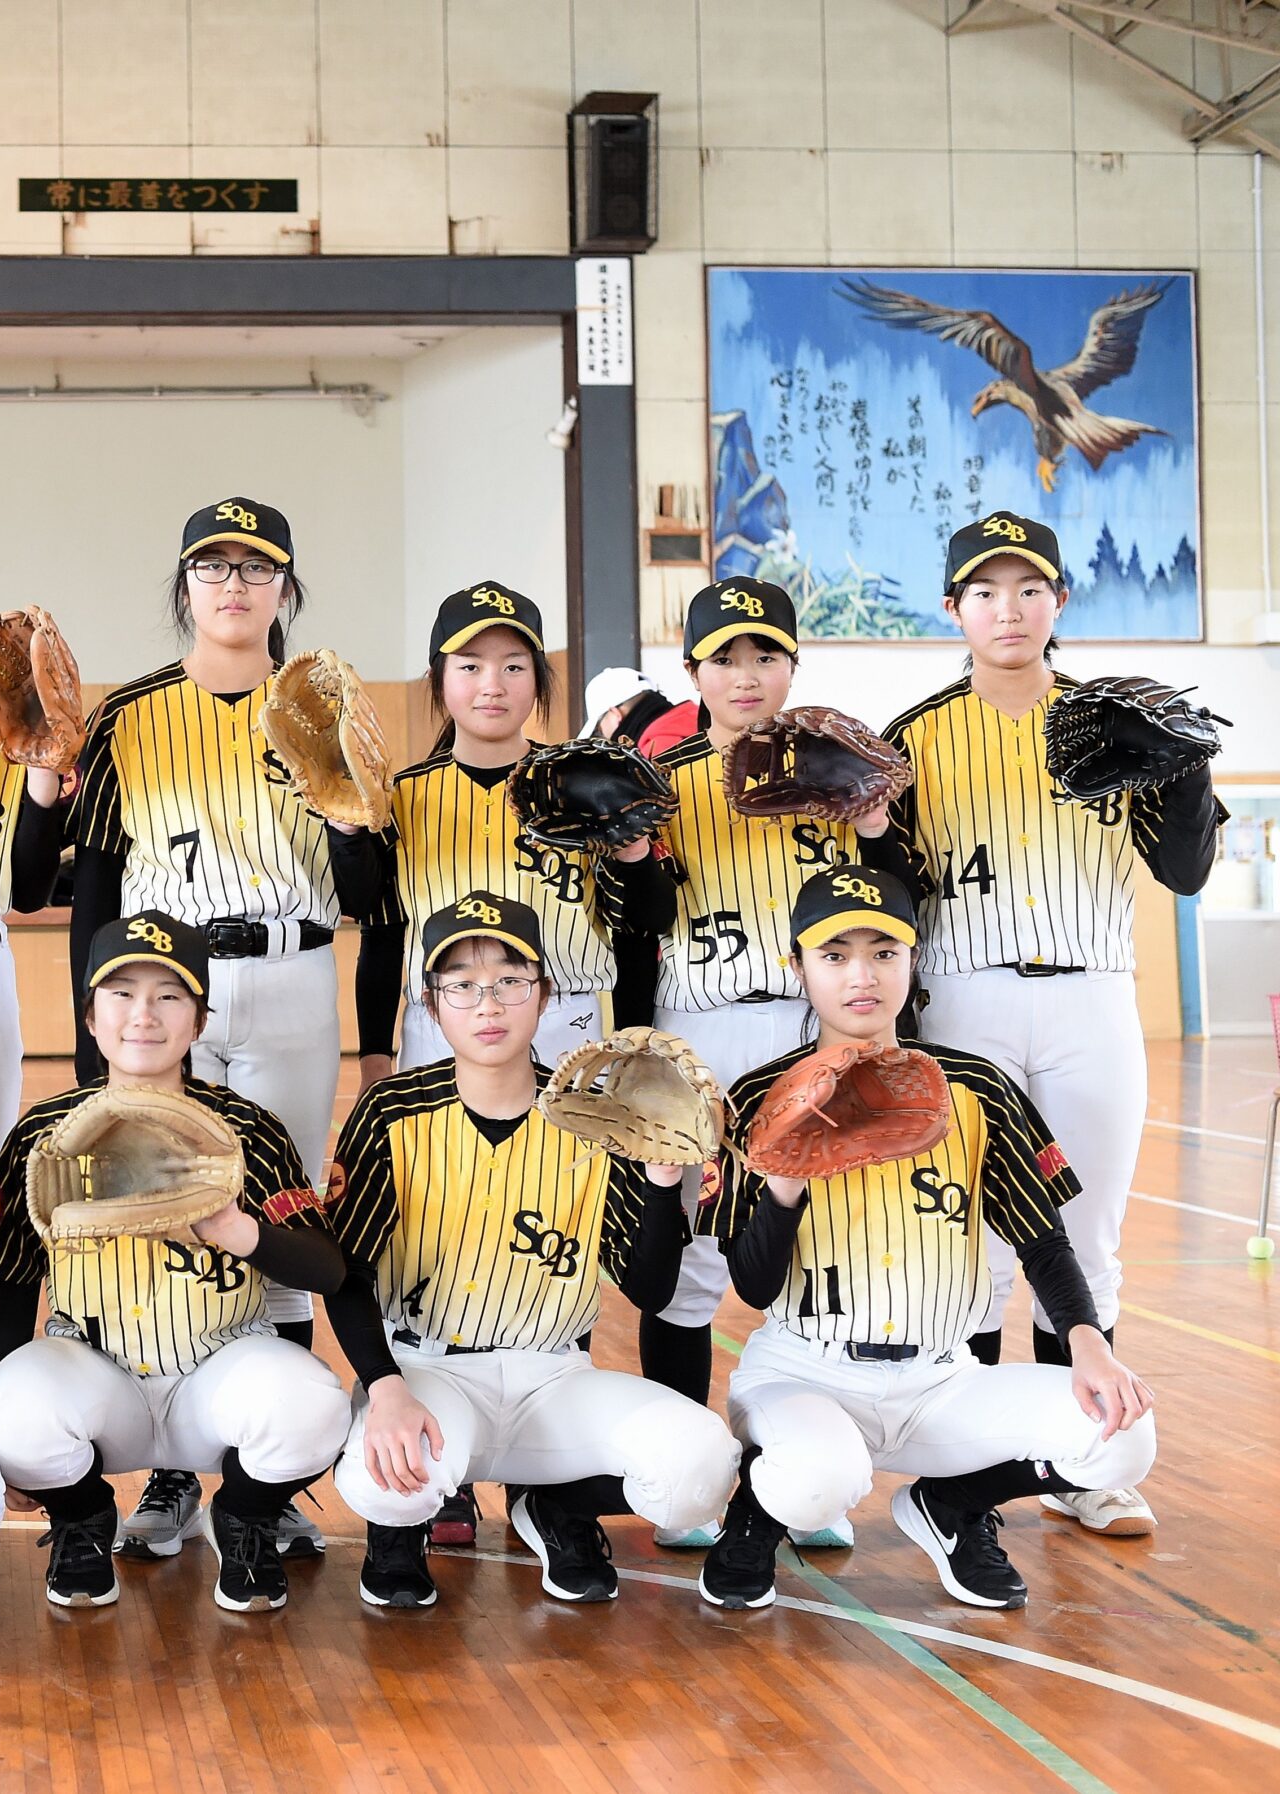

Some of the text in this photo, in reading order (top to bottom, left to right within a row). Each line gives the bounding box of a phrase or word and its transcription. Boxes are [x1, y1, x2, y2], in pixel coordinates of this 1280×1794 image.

[46, 180, 271, 209] 常に最善をつくす
[169, 829, 200, 884] 7
[941, 843, 997, 900] 14
[688, 910, 749, 965] 55
[797, 1265, 847, 1317] 11
